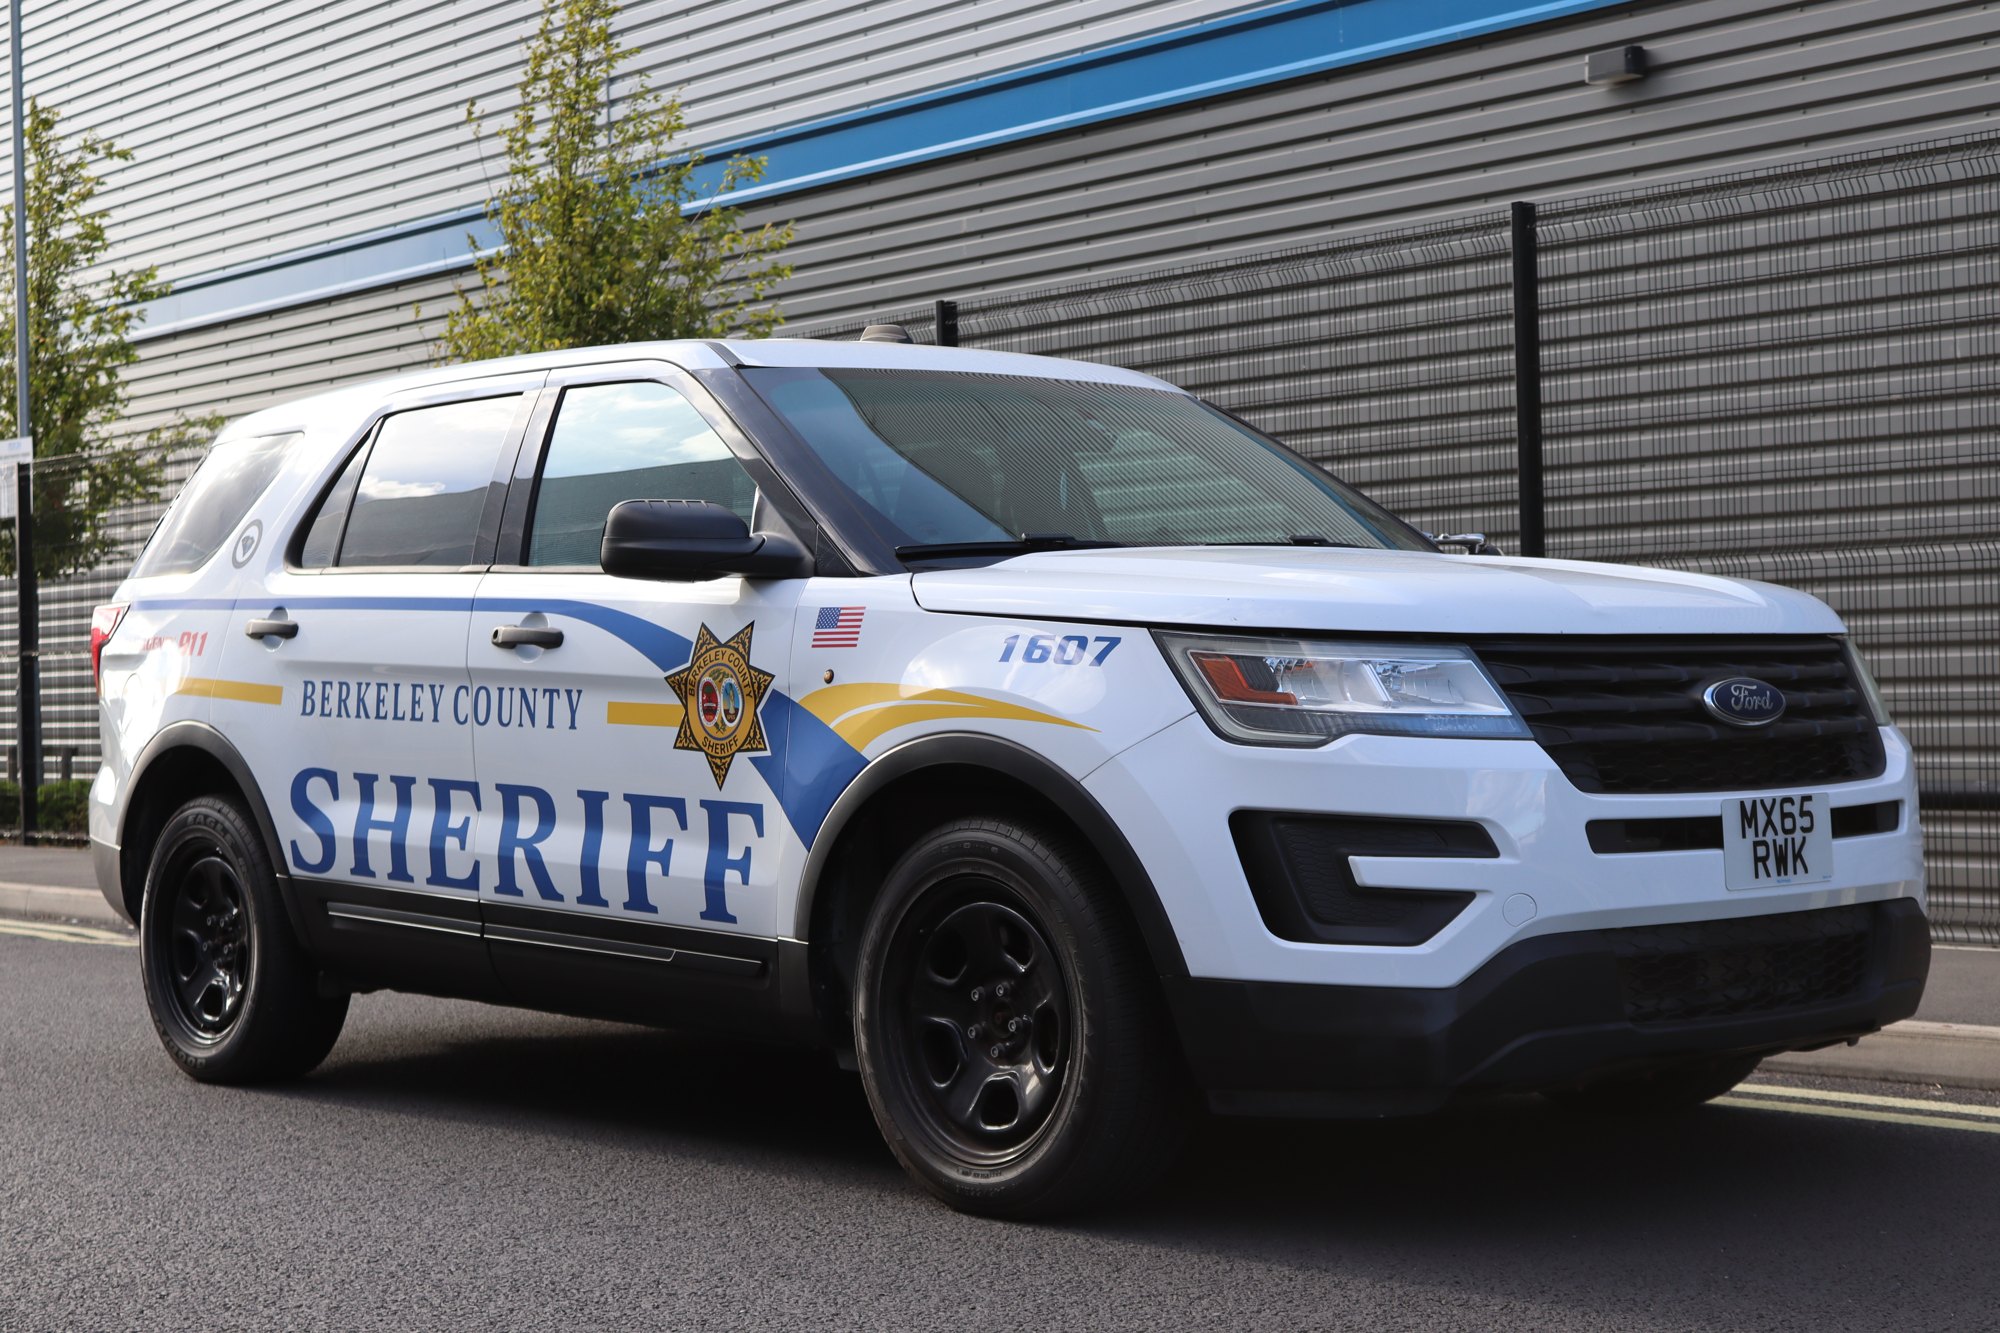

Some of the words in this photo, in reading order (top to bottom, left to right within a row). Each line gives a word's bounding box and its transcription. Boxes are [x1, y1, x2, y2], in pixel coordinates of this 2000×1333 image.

[178, 631, 208, 656] 911
[998, 634, 1122, 667] 1607
[688, 650, 727, 698] BERKELEY
[727, 652, 753, 698] COUNTY
[301, 680, 444, 723] BERKELEY
[453, 685, 583, 730] COUNTY
[1731, 684, 1774, 711] Ford
[701, 735, 739, 755] SHERIFF
[1740, 795, 1815, 839] MX65
[290, 767, 764, 924] SHERIFF
[1753, 836, 1809, 879] RWK
